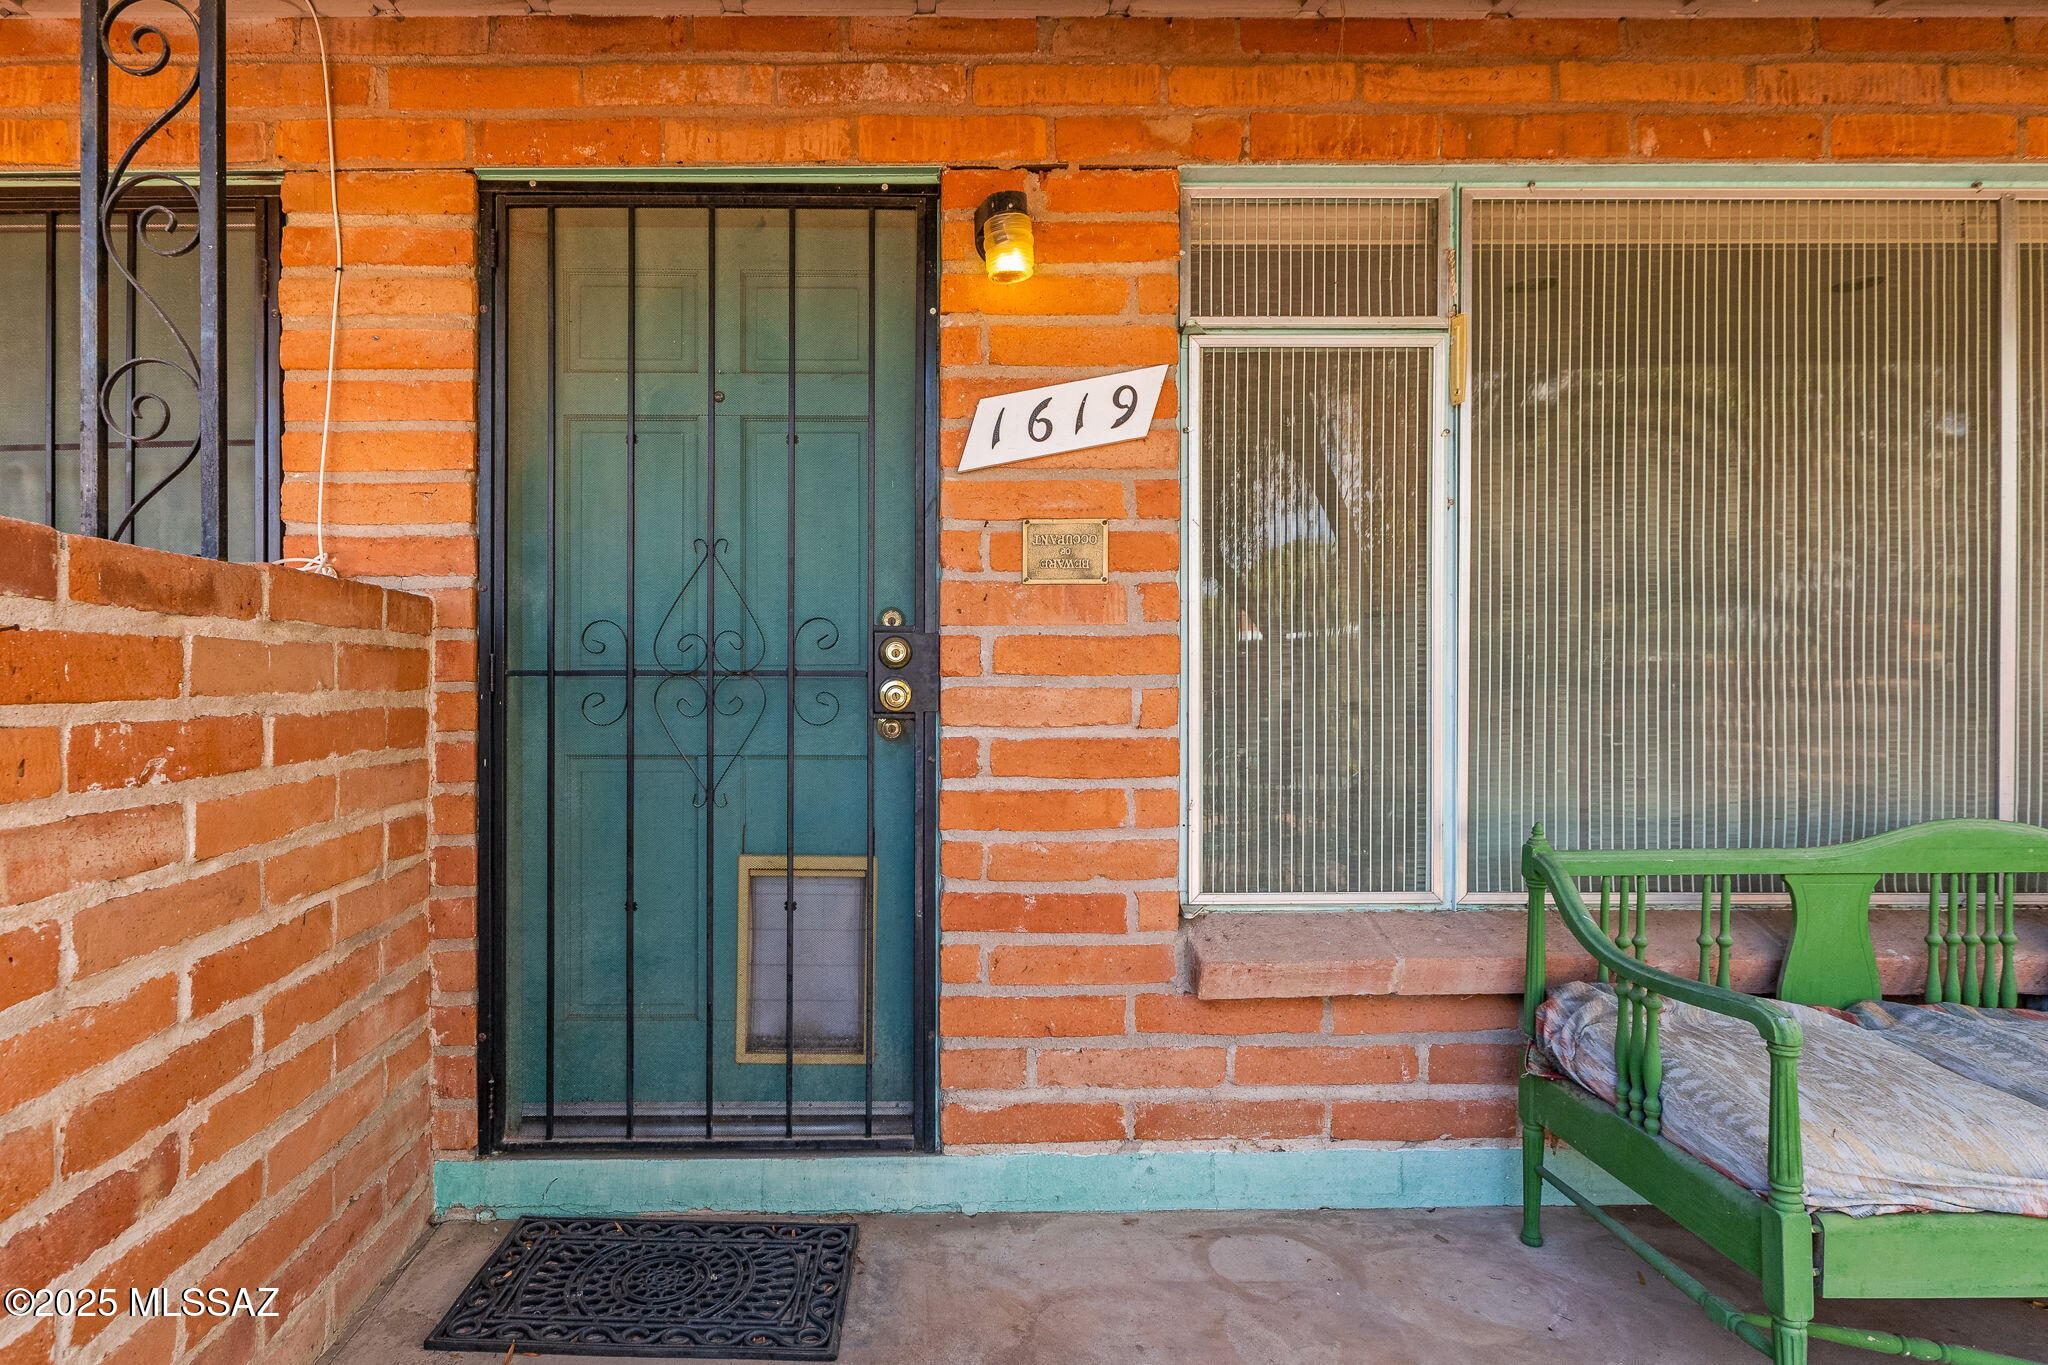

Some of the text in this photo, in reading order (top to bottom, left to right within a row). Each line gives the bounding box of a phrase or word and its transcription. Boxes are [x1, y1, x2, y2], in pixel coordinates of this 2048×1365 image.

[991, 384, 1138, 450] 1619
[1032, 534, 1098, 546] OCCUPANT
[1060, 547, 1072, 555] OF
[1040, 558, 1090, 569] BEWARE
